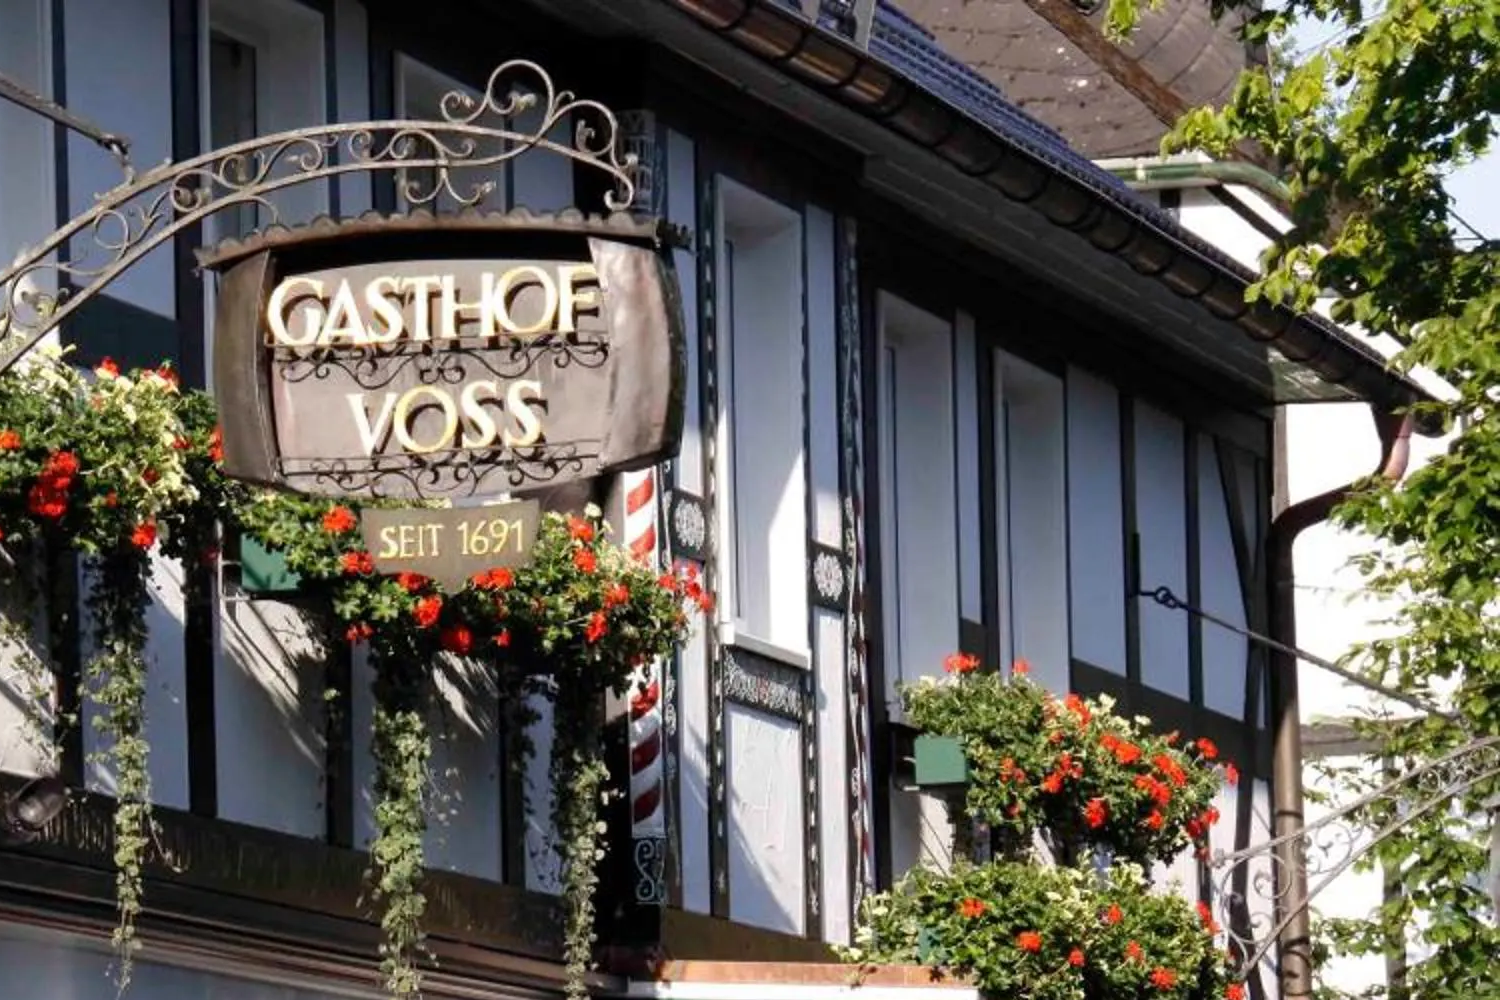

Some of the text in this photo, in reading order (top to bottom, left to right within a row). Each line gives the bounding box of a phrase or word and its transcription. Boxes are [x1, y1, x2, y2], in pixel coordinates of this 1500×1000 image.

[267, 265, 599, 349] GASTHOF
[348, 380, 545, 456] VOSS
[379, 519, 524, 559] SEIT 1691
